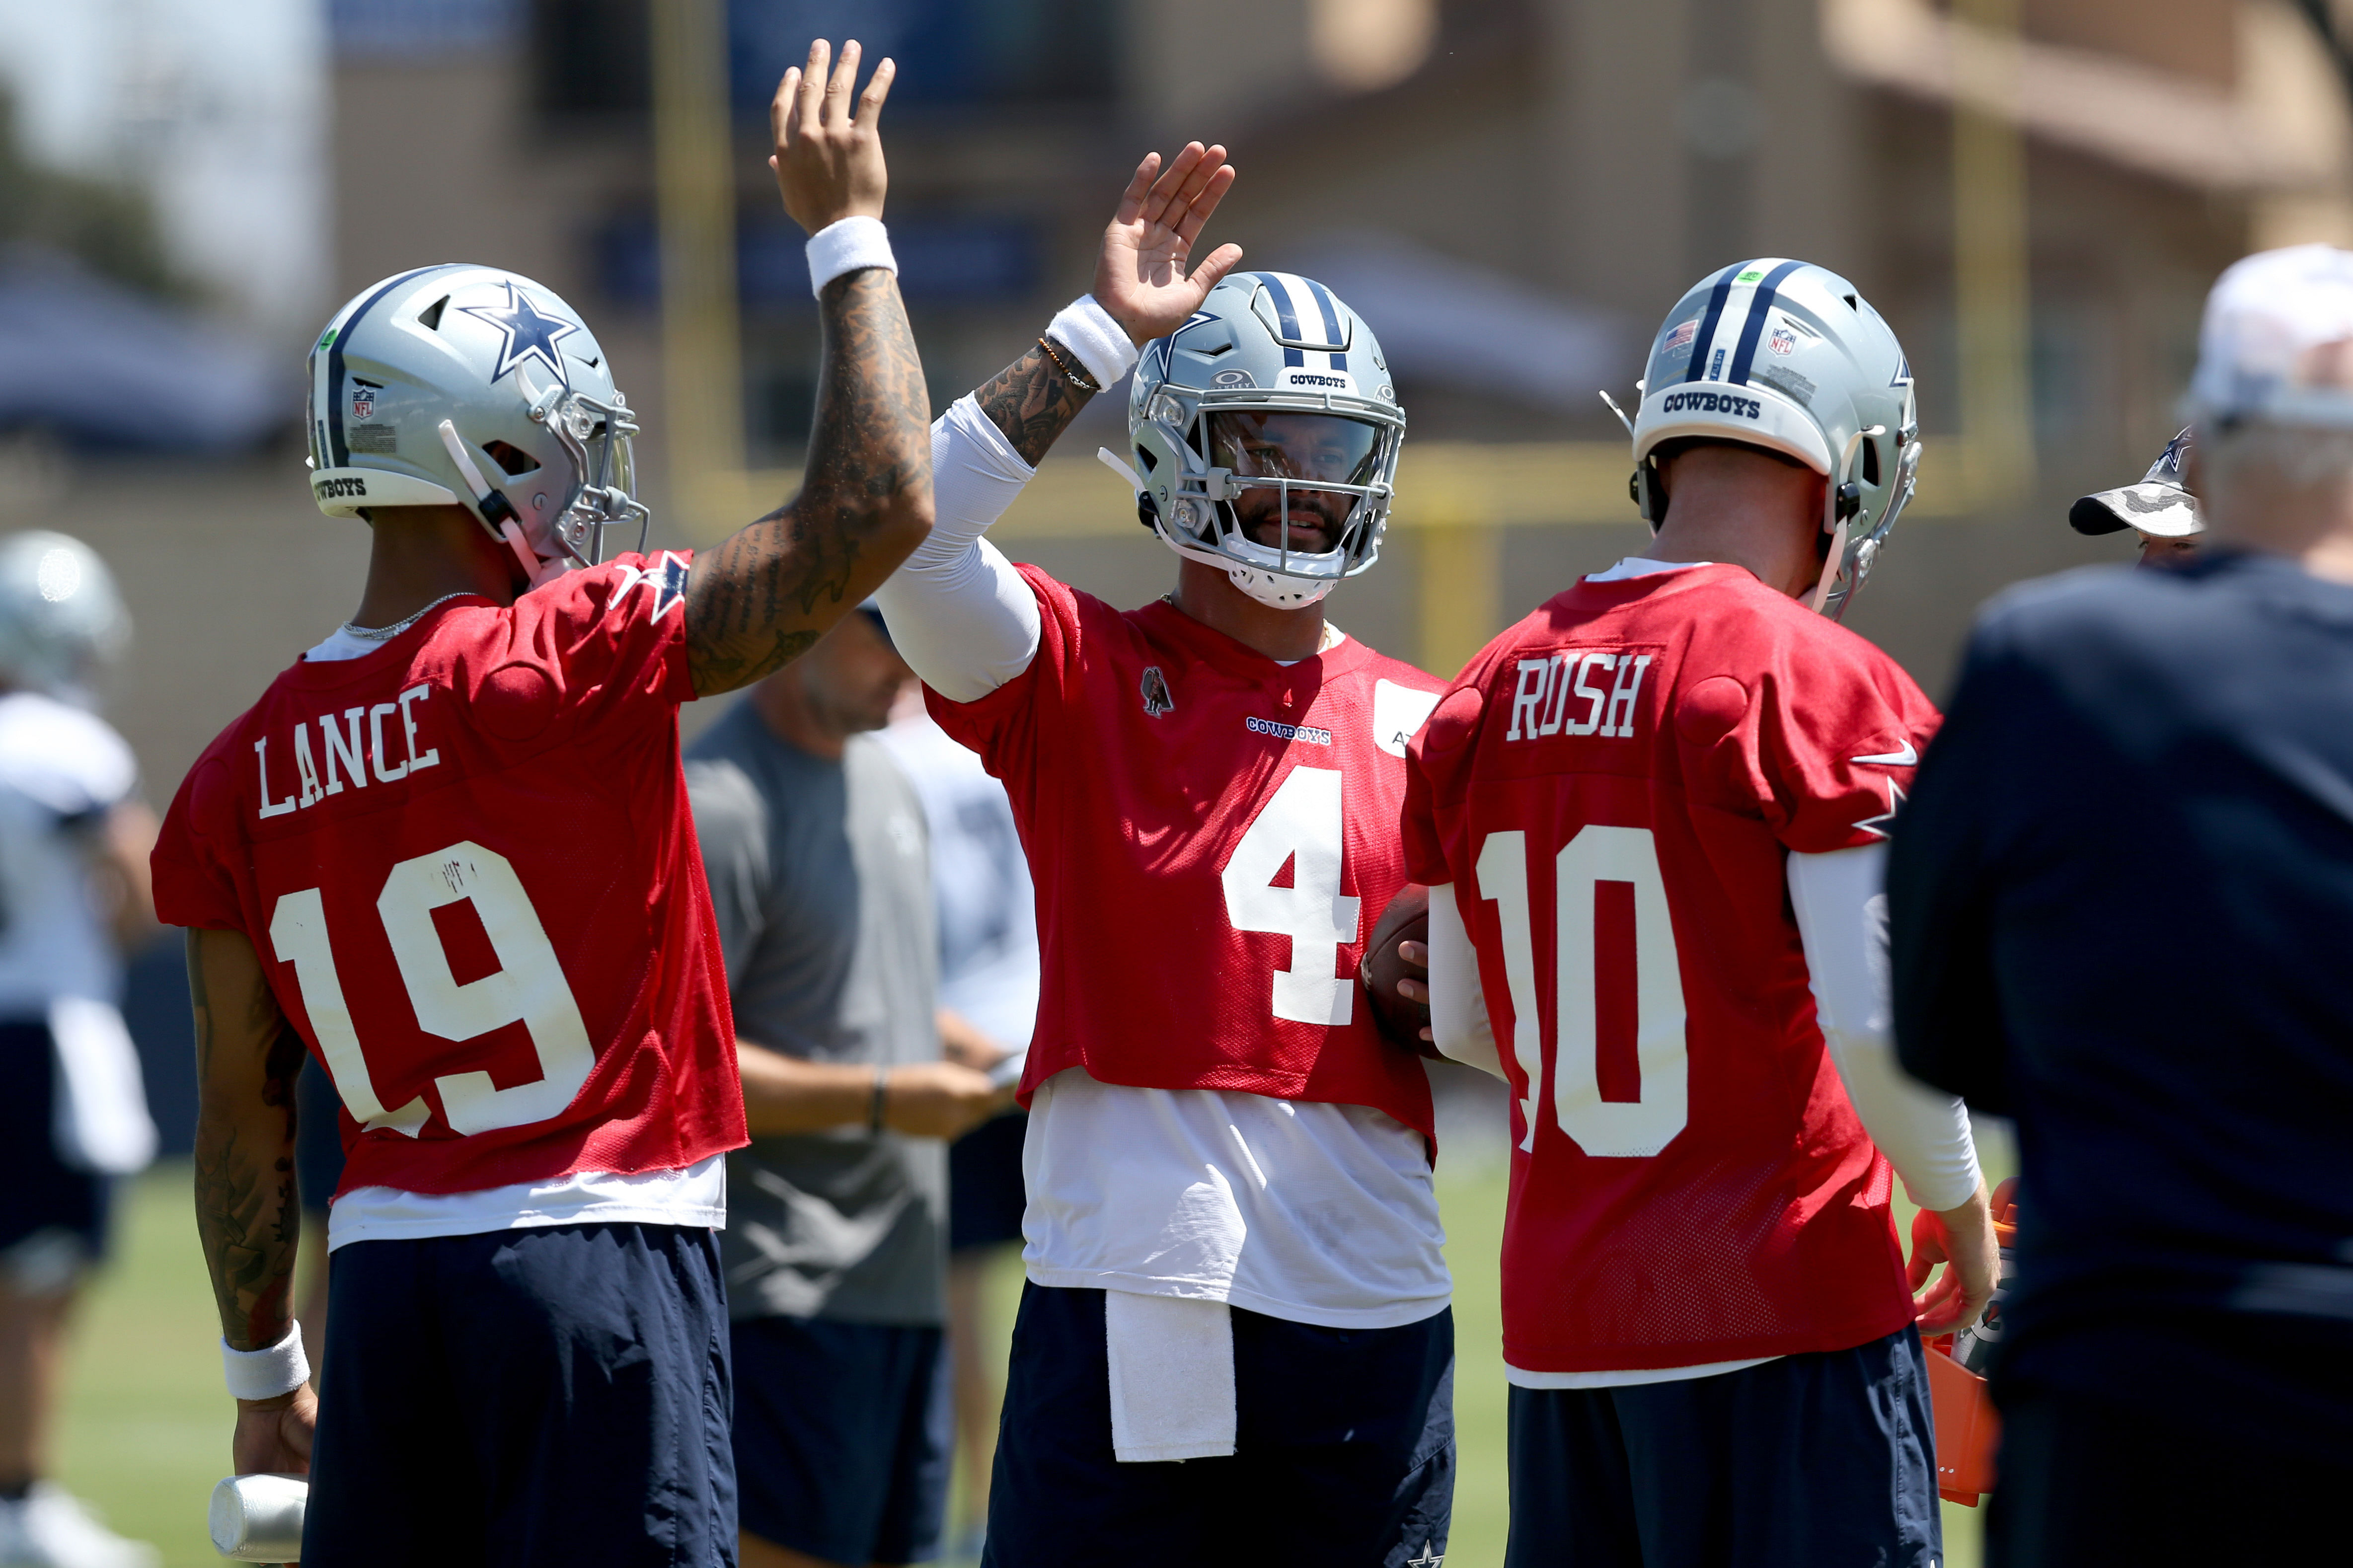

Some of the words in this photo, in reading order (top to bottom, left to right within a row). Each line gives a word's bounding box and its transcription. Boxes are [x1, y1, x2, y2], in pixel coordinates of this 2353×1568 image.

[1771, 337, 1790, 353] NFL
[1290, 374, 1346, 388] COWBOYS
[354, 402, 372, 417] NFL
[1663, 392, 1760, 420] COWBOYS
[1506, 653, 1653, 742] RUSH
[1246, 717, 1331, 745] COWBOYS
[1392, 731, 1411, 747] A
[254, 683, 440, 820] LANCE
[1221, 765, 1361, 1026] 4
[269, 840, 596, 1139] 19
[1475, 824, 1688, 1157] 10
